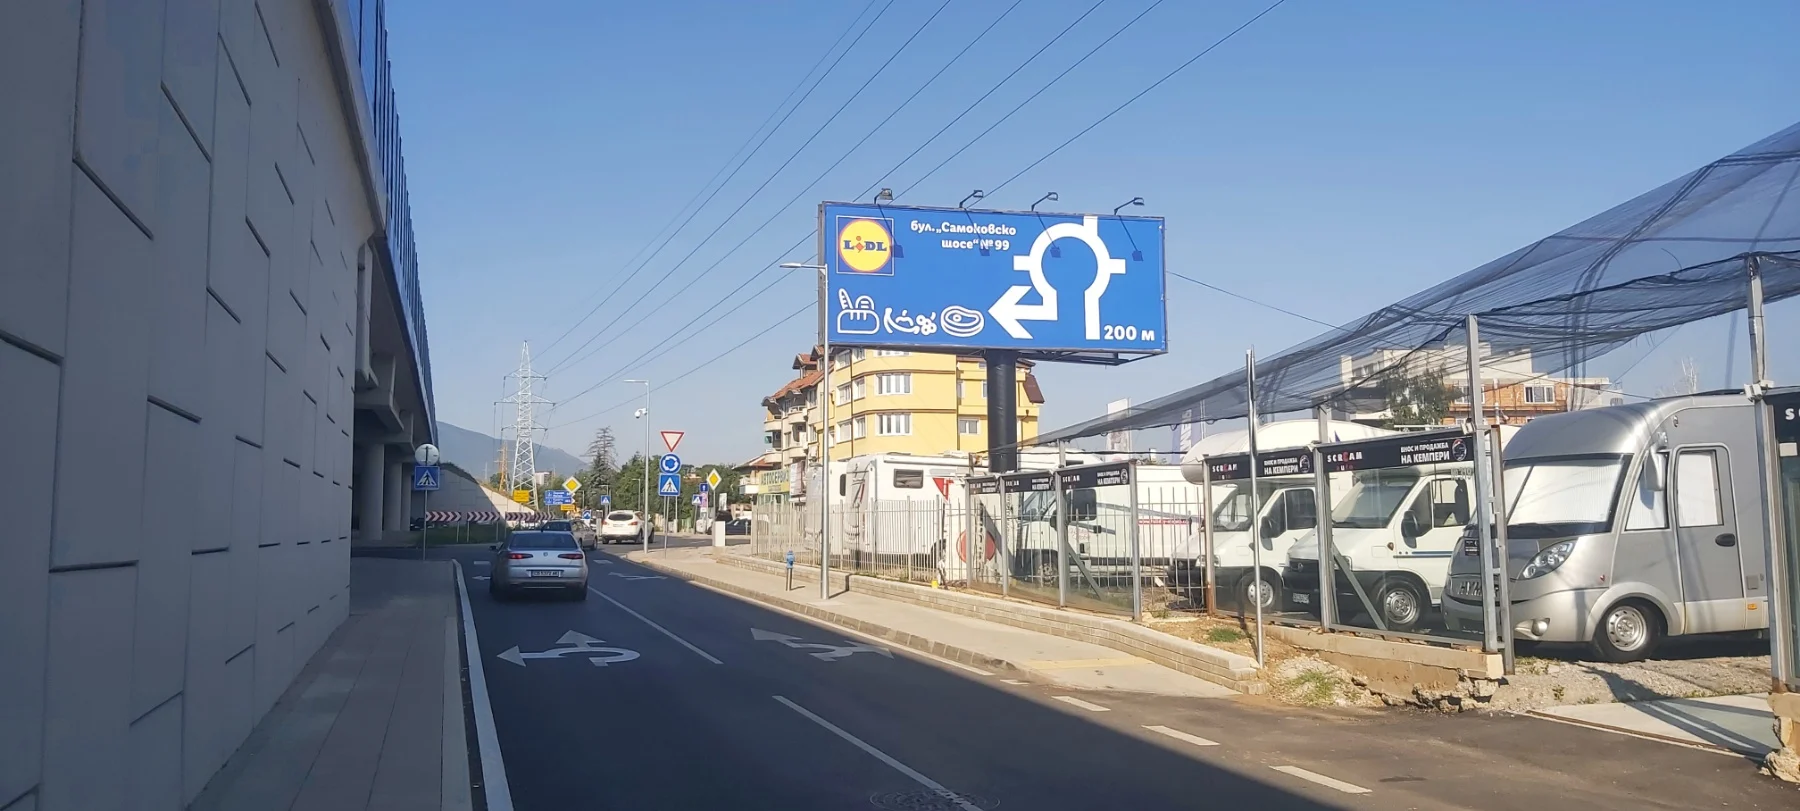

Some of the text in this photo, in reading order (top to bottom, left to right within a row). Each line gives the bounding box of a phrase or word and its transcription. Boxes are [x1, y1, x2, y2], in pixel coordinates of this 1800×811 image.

[910, 220, 935, 234] бул.
[995, 240, 1010, 251] 99
[1103, 324, 1155, 341] 200 м
[1785, 408, 1800, 421] S
[1401, 451, 1450, 464] НА КЕМПЕРИ
